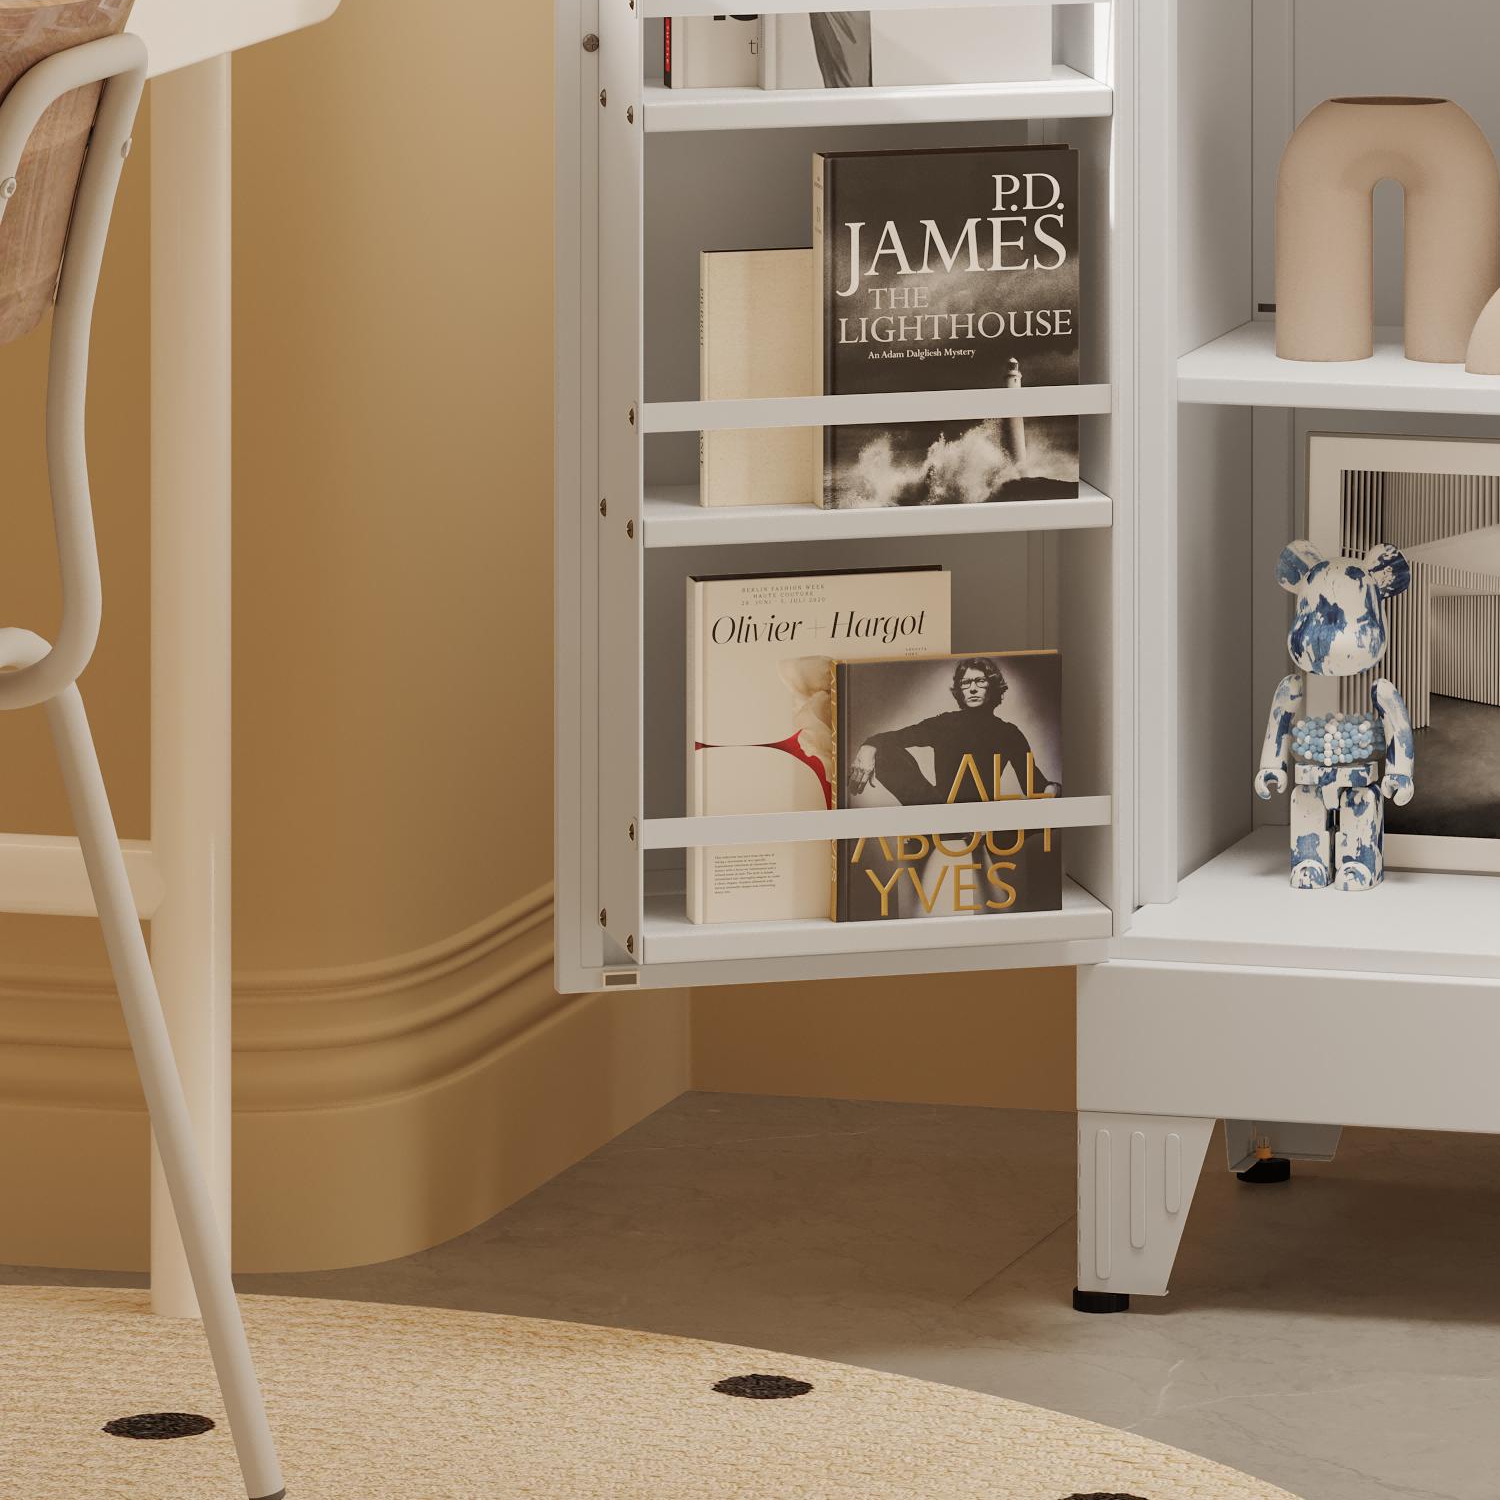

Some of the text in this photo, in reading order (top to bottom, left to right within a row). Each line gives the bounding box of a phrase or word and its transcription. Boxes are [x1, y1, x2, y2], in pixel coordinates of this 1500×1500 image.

[991, 172, 1066, 213] P.D.
[836, 213, 1067, 298] JAMES
[868, 286, 929, 311] THE
[838, 309, 1074, 345] LIGHTHOUSE
[868, 347, 976, 361] An Adam Dalgliesh Mystery
[711, 614, 803, 645] Olivier
[946, 751, 1053, 804] ALL
[865, 862, 1018, 916] YVES
